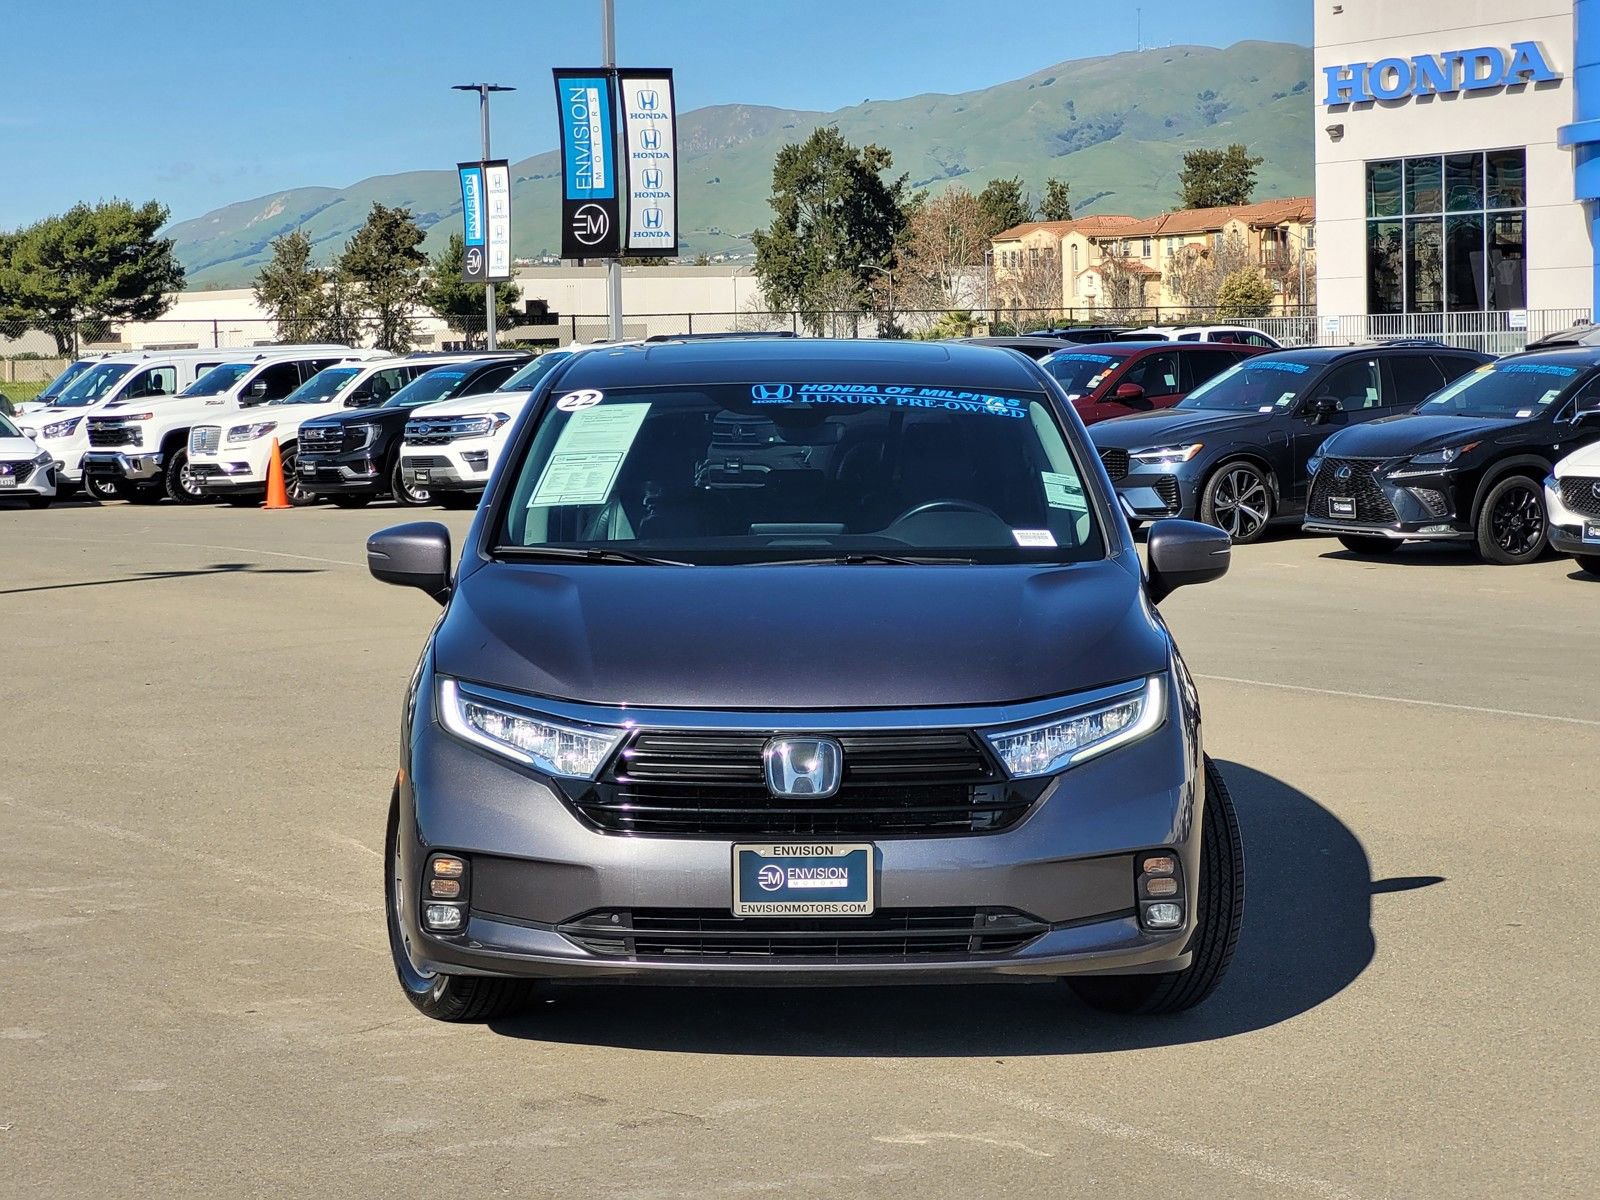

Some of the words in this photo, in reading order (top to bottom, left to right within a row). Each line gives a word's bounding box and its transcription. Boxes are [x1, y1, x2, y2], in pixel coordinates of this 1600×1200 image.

[1322, 41, 1558, 105] HONDA
[630, 112, 668, 120] HONDA
[569, 87, 592, 190] ENVISION
[589, 96, 602, 180] MOTORS
[634, 191, 671, 199] HONDA
[464, 174, 476, 240] ENVISION
[561, 393, 597, 408] 22
[800, 384, 878, 393] HONDA
[885, 386, 916, 394] OF
[919, 388, 1021, 407] MILPITAS
[800, 394, 892, 405] LUXURY
[896, 397, 1025, 418] PRE-OWNED
[773, 846, 834, 856] ENVISION
[787, 867, 848, 879] ENVISION
[741, 904, 867, 913] ENVISIONMOTORS.COM
